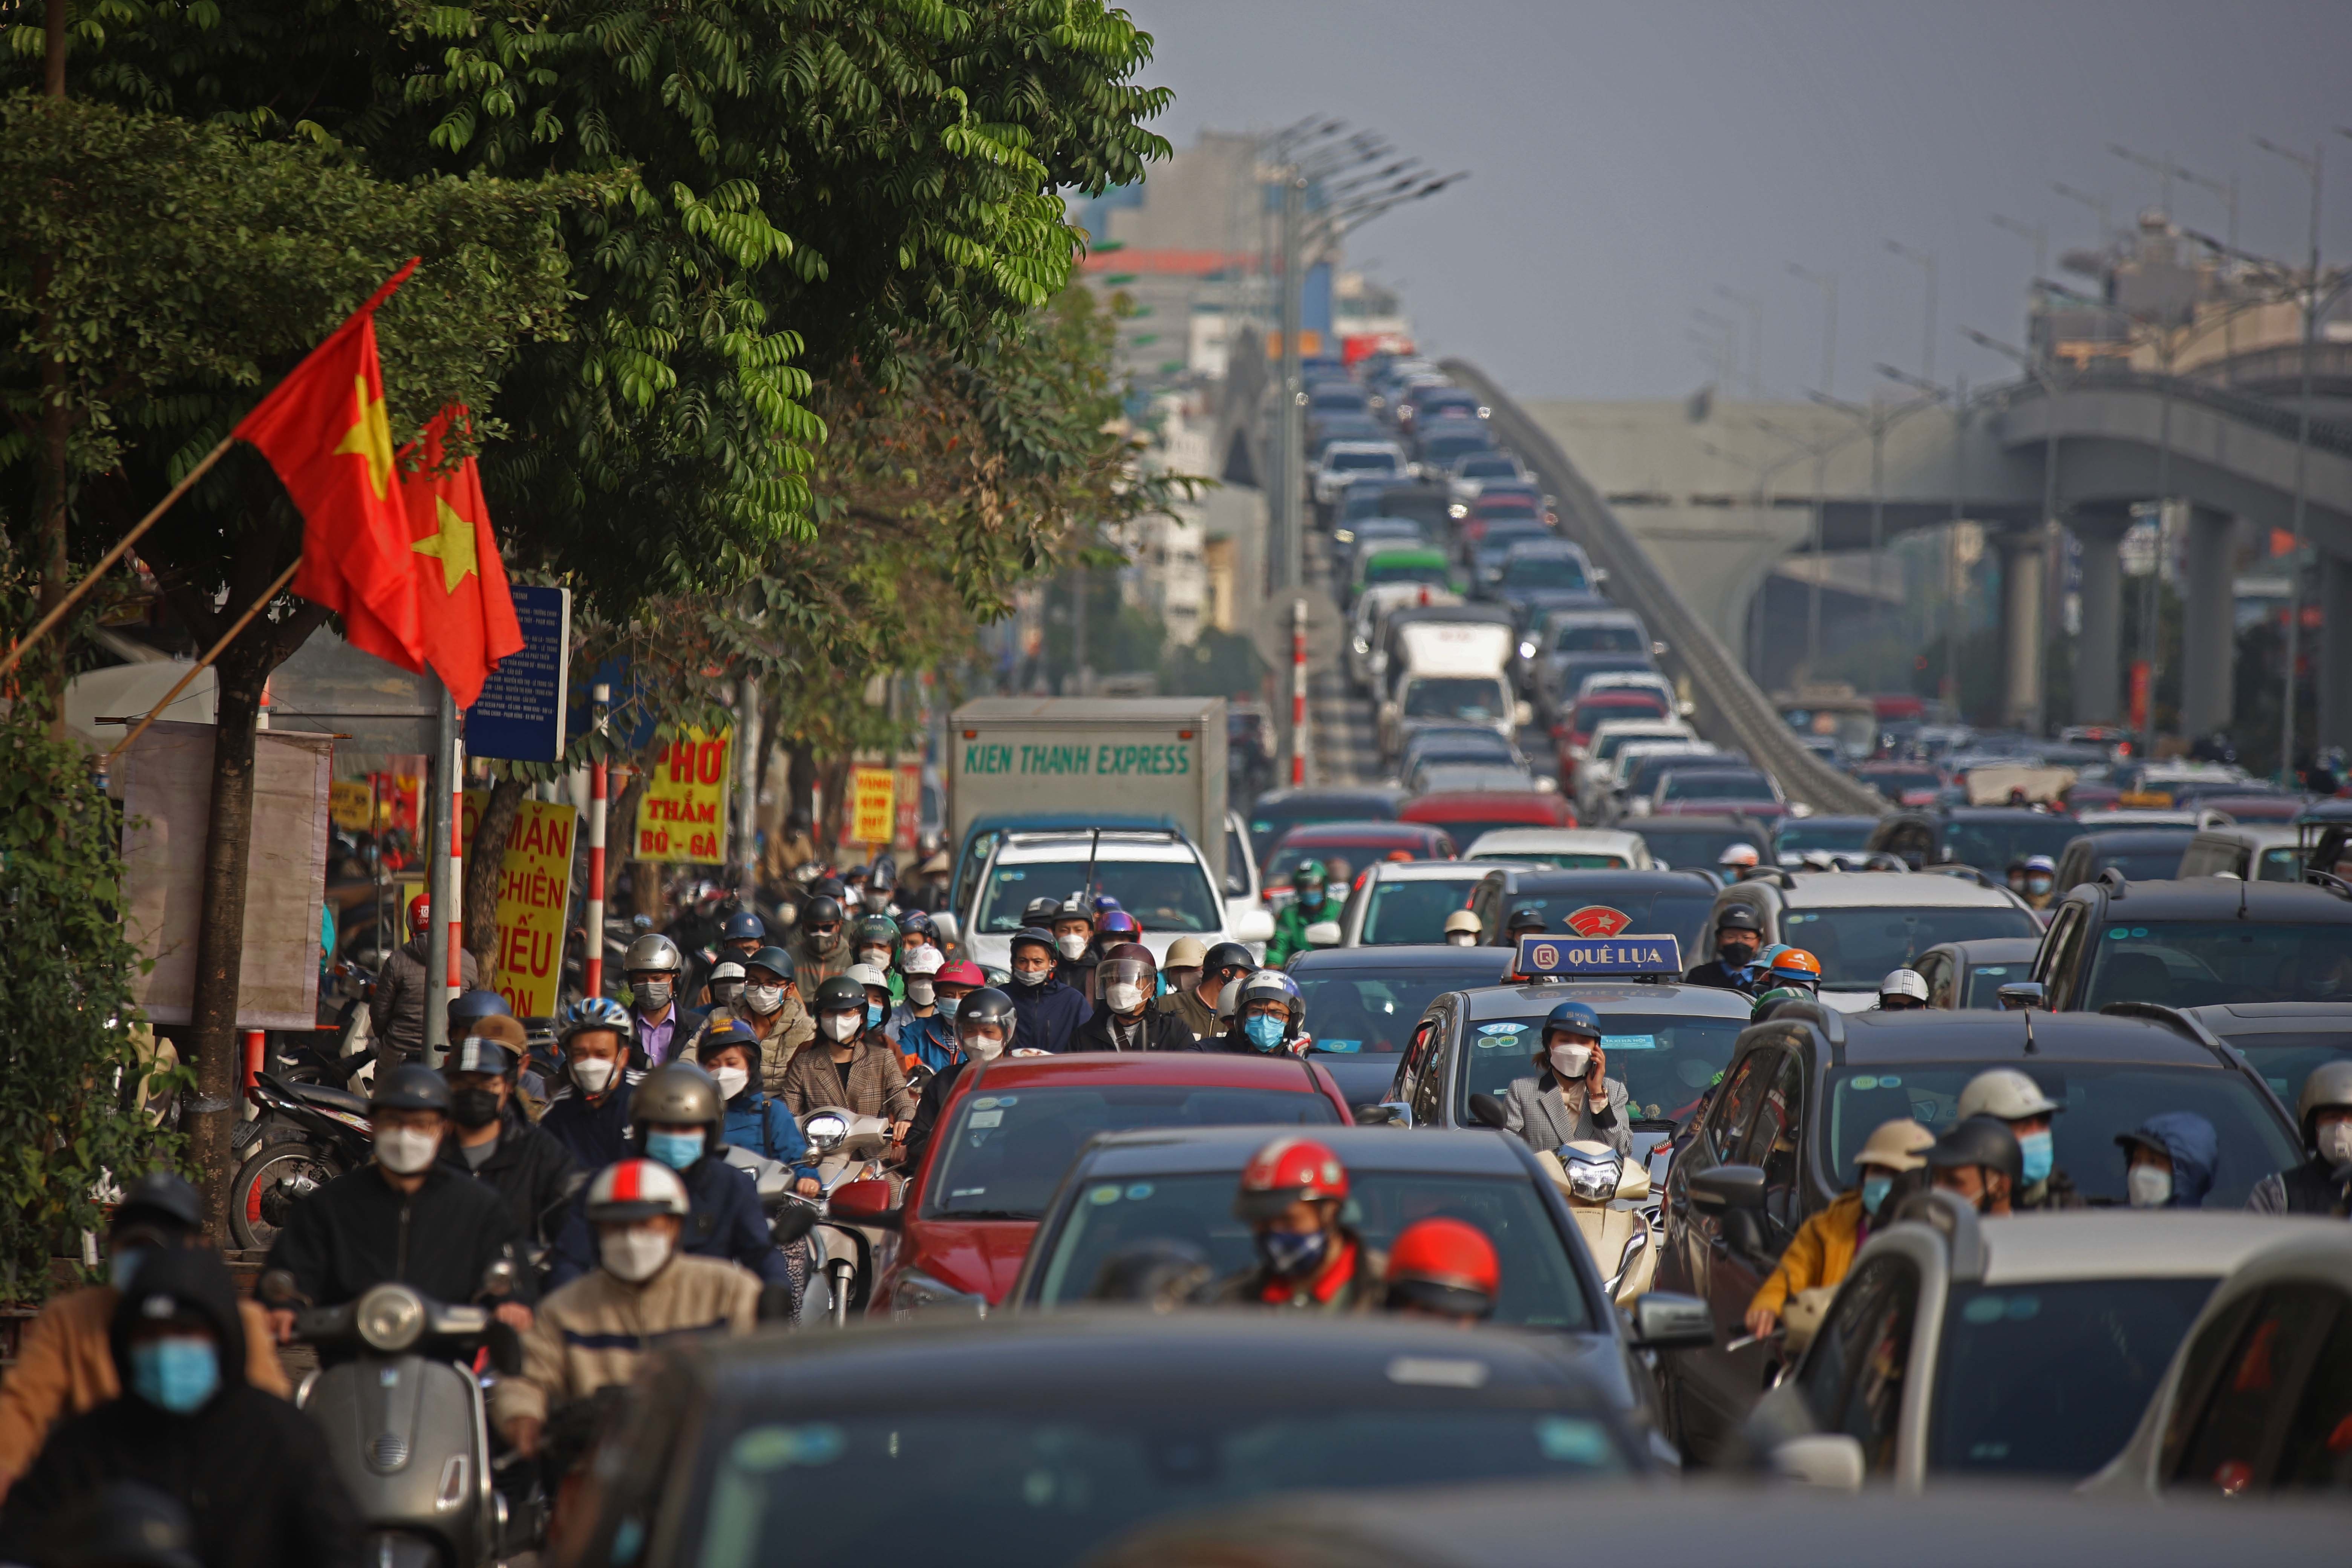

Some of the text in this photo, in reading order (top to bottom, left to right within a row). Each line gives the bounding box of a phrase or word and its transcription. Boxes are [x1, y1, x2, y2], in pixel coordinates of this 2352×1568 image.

[513, 591, 527, 600] TRÌNH
[964, 744, 1190, 775] KIEN THANH EXPRESS
[640, 826, 668, 854] BÒ
[690, 831, 717, 858] GÀ
[497, 865, 564, 910] CHIÊN
[498, 913, 552, 978] IẾU
[1569, 944, 1614, 967] QUÊ
[1618, 947, 1663, 968] LỤA
[493, 977, 533, 1018] ÒN
